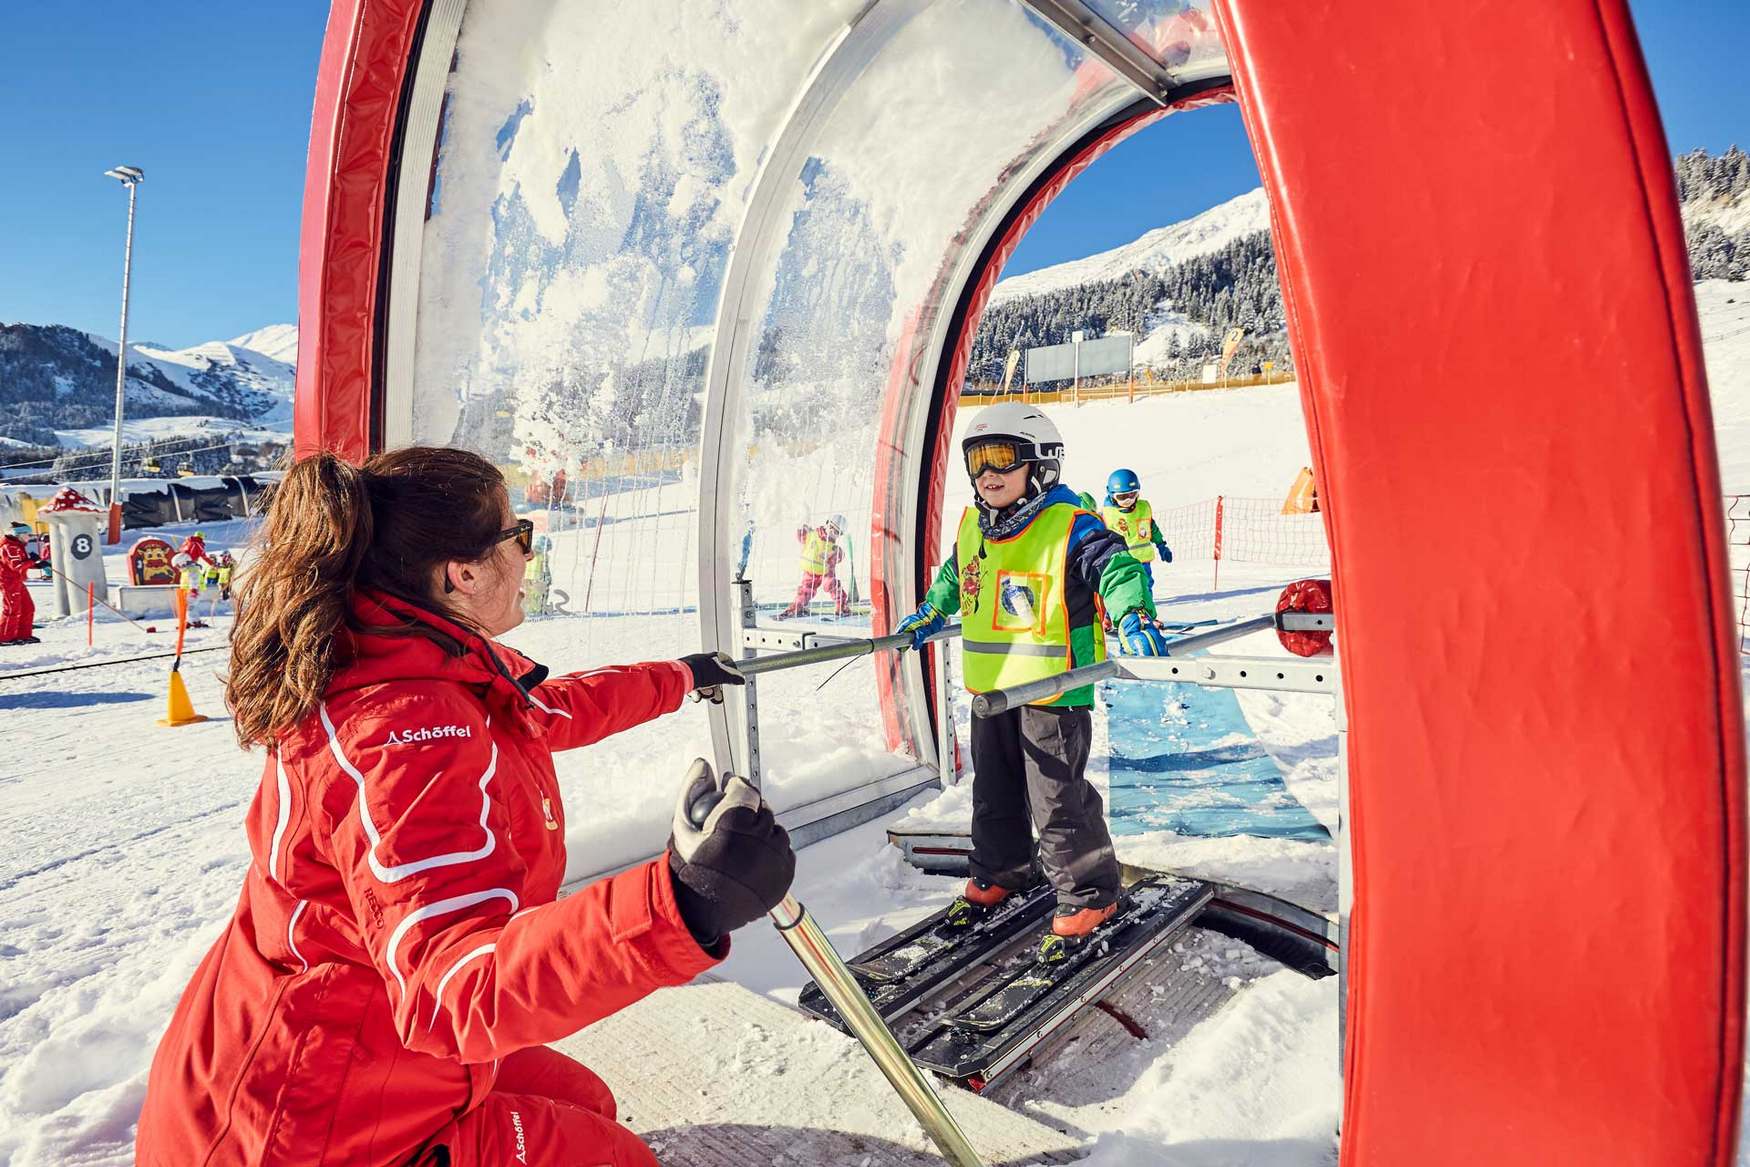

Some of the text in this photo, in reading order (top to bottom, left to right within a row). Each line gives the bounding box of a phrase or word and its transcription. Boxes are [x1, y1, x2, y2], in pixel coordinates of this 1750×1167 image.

[1231, 330, 1239, 342] 2
[76, 537, 90, 553] 8
[402, 725, 472, 743] Schöffel
